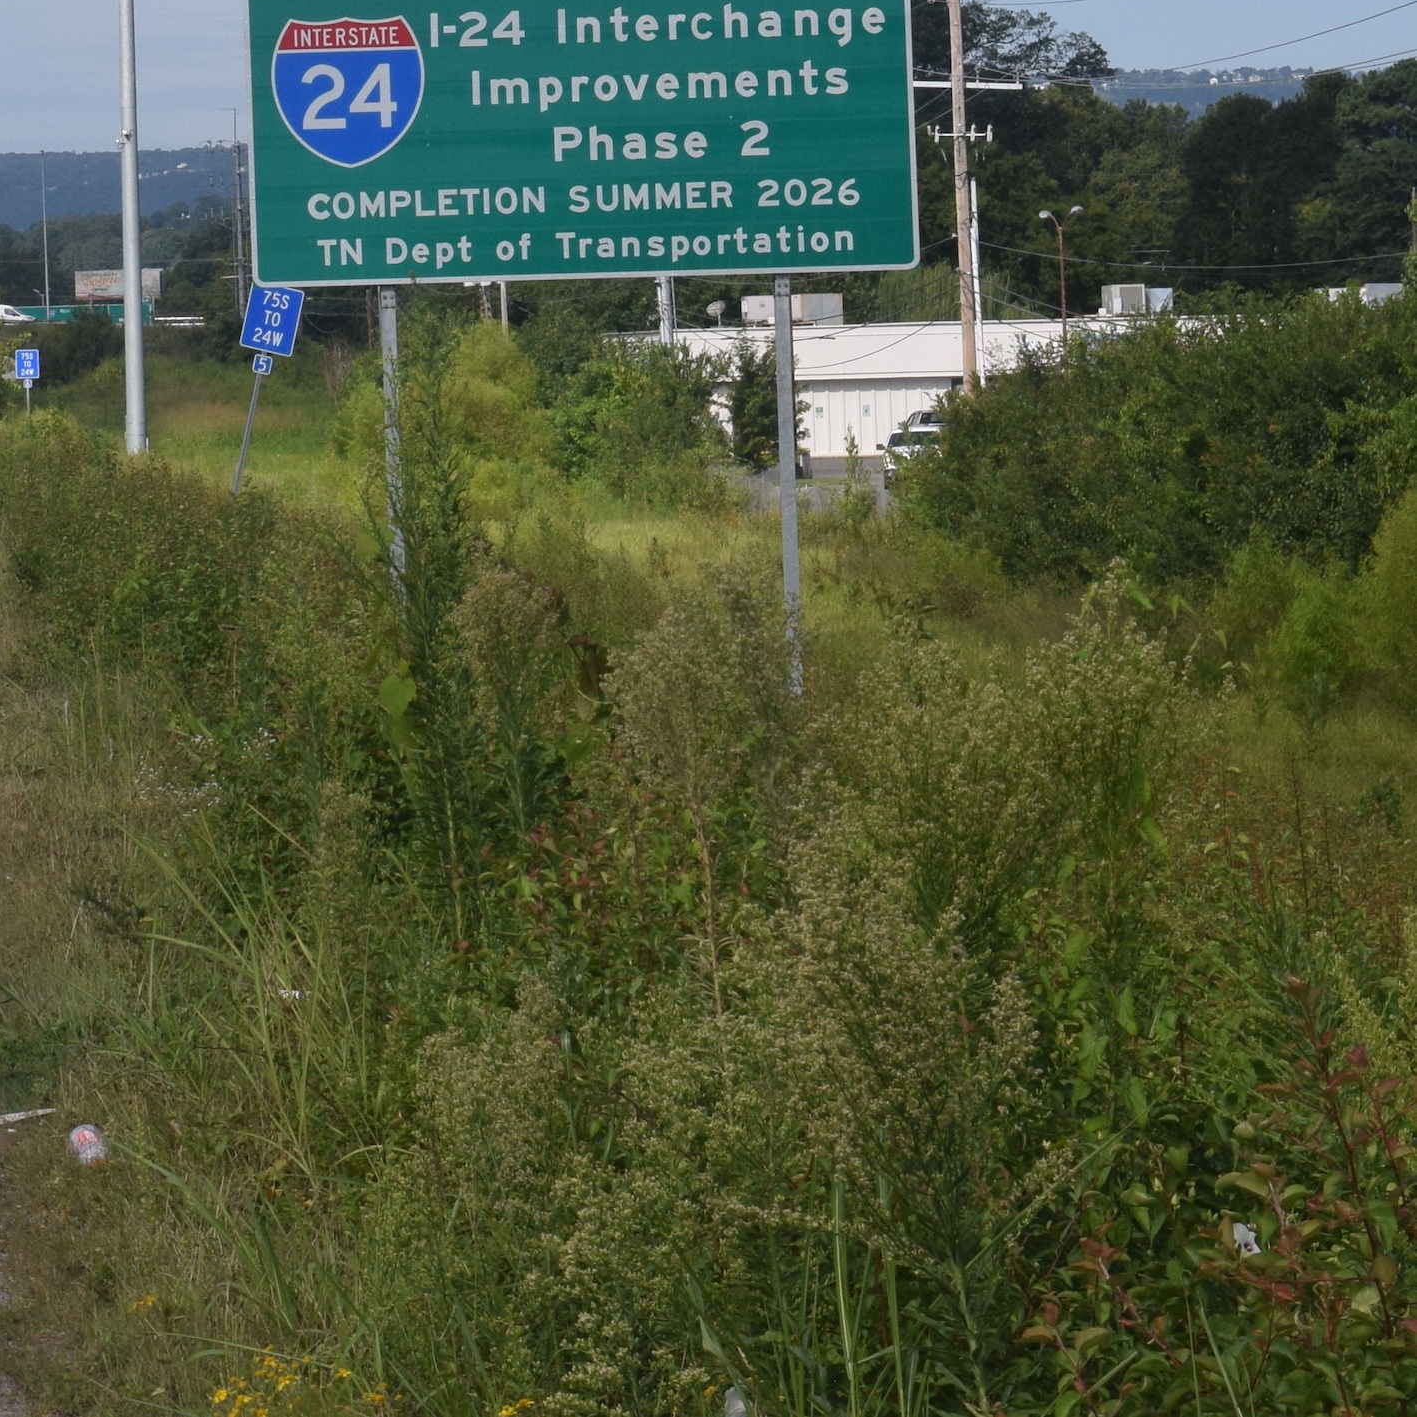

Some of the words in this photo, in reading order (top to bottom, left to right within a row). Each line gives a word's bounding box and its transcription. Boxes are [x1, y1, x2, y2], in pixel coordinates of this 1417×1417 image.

[293, 24, 400, 48] INTERSTATE
[429, 9, 526, 48] I-24
[557, 2, 886, 47] Interchange
[302, 62, 398, 131] 24
[471, 59, 850, 112] Improvements
[553, 124, 708, 162] Phase
[740, 120, 770, 157] 2
[307, 186, 546, 220] COMPLETION
[568, 181, 734, 214] SUMMER
[757, 177, 861, 207] 2026
[317, 239, 363, 266] TN
[385, 236, 472, 269] Dept
[496, 232, 531, 261] of
[555, 226, 855, 262] Transportation
[263, 290, 290, 310] 75S
[264, 310, 281, 327] TO
[252, 327, 284, 347] 24W
[20, 352, 34, 360] 75S
[23, 360, 32, 368] TO
[257, 357, 267, 372] 5
[20, 368, 34, 376] 24W
